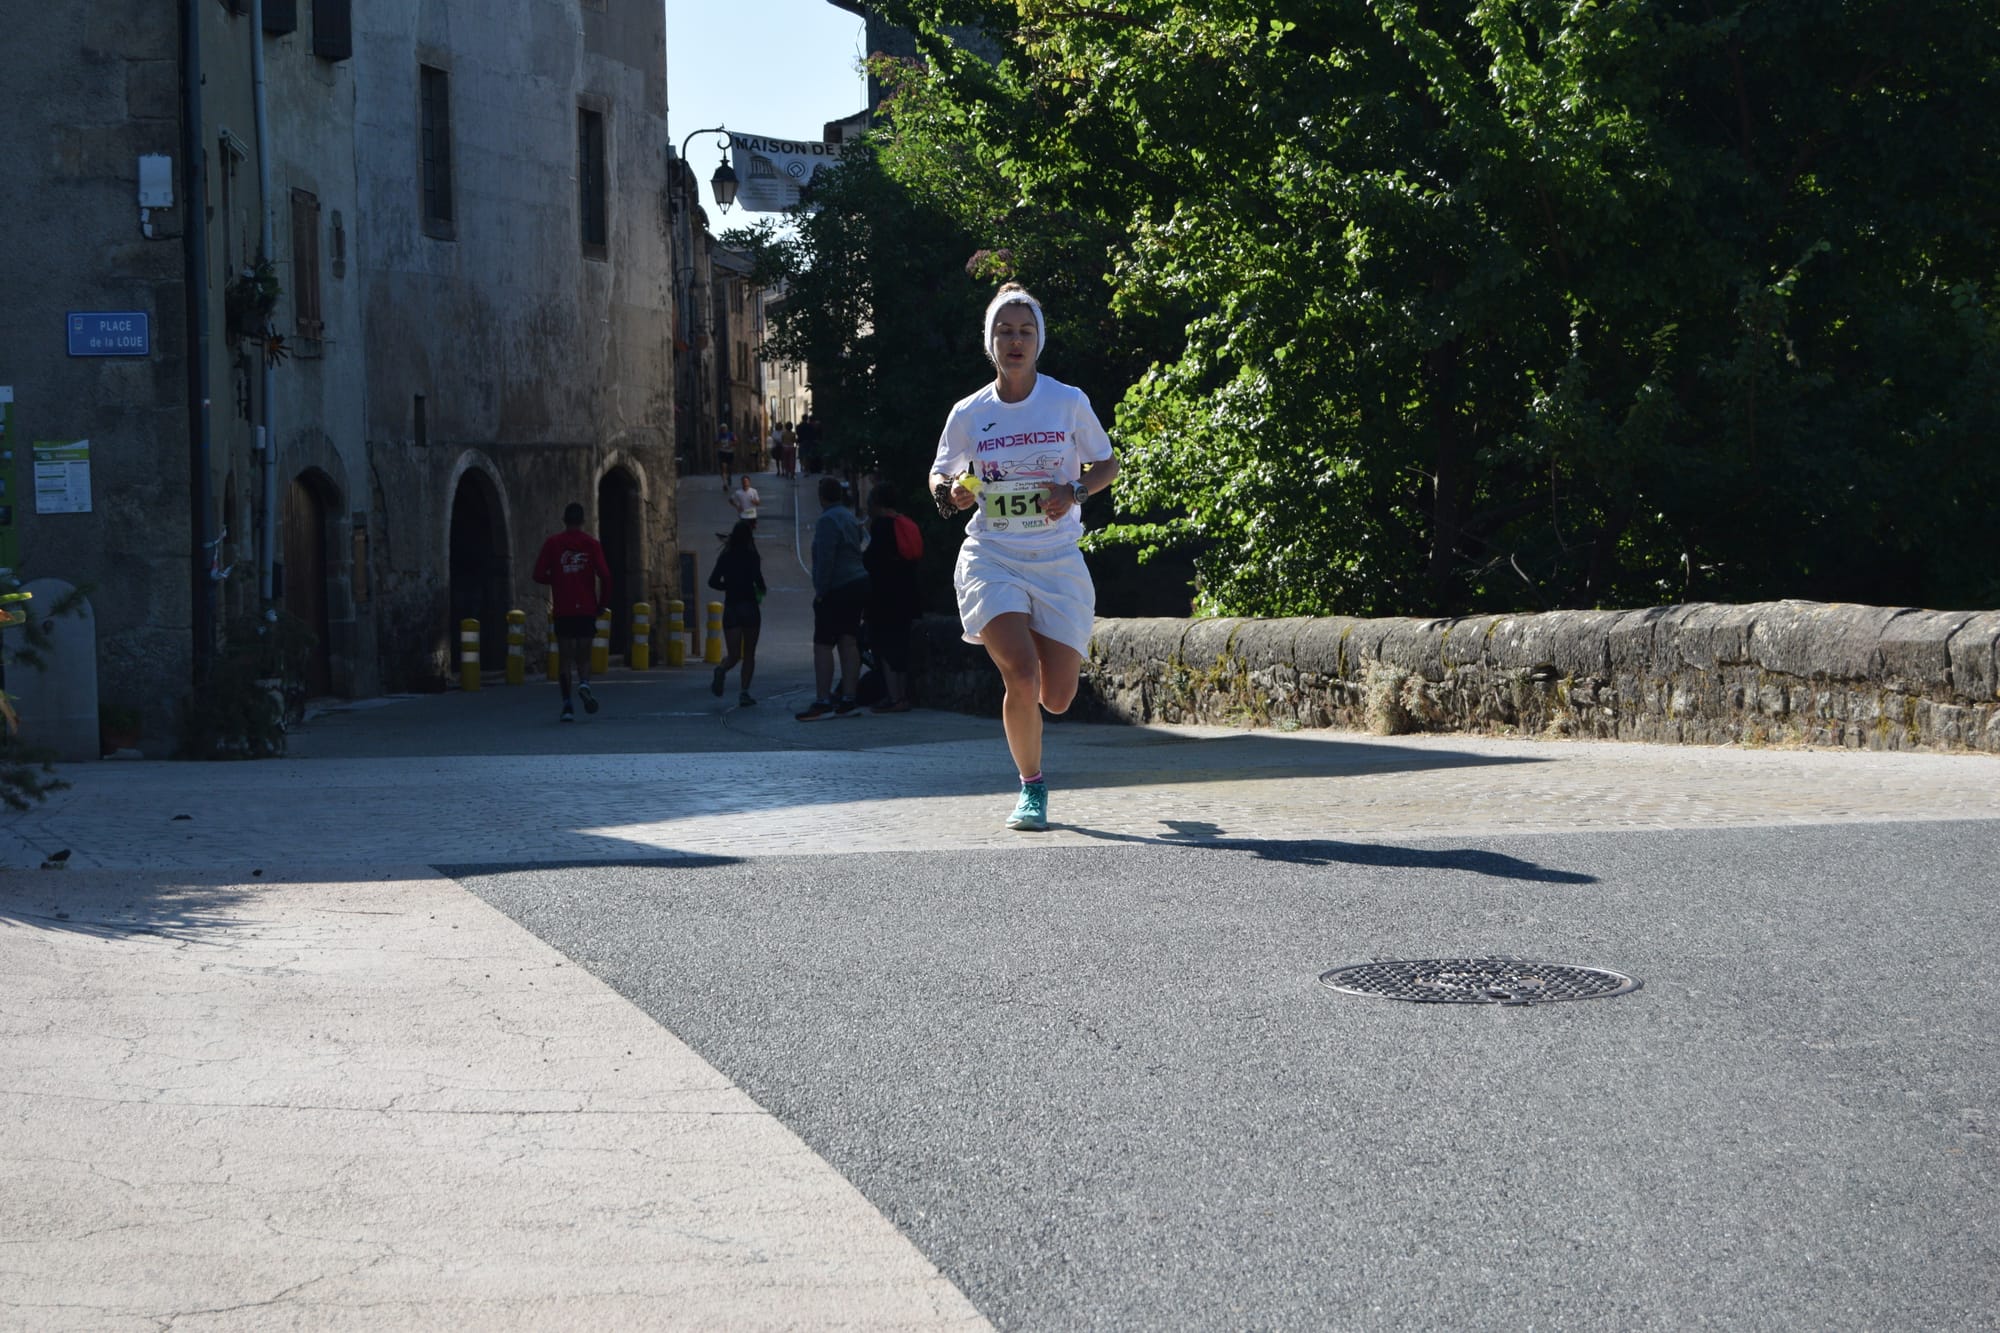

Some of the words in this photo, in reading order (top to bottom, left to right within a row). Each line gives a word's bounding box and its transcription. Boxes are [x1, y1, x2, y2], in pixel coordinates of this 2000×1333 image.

[736, 136, 806, 155] MAISON
[812, 143, 835, 156] DE
[100, 320, 132, 331] PLACE
[90, 336, 102, 347] de
[105, 336, 114, 347] la
[117, 336, 143, 347] LOUE
[976, 431, 1065, 453] MENDEKIDEN
[994, 493, 1042, 516] 151
